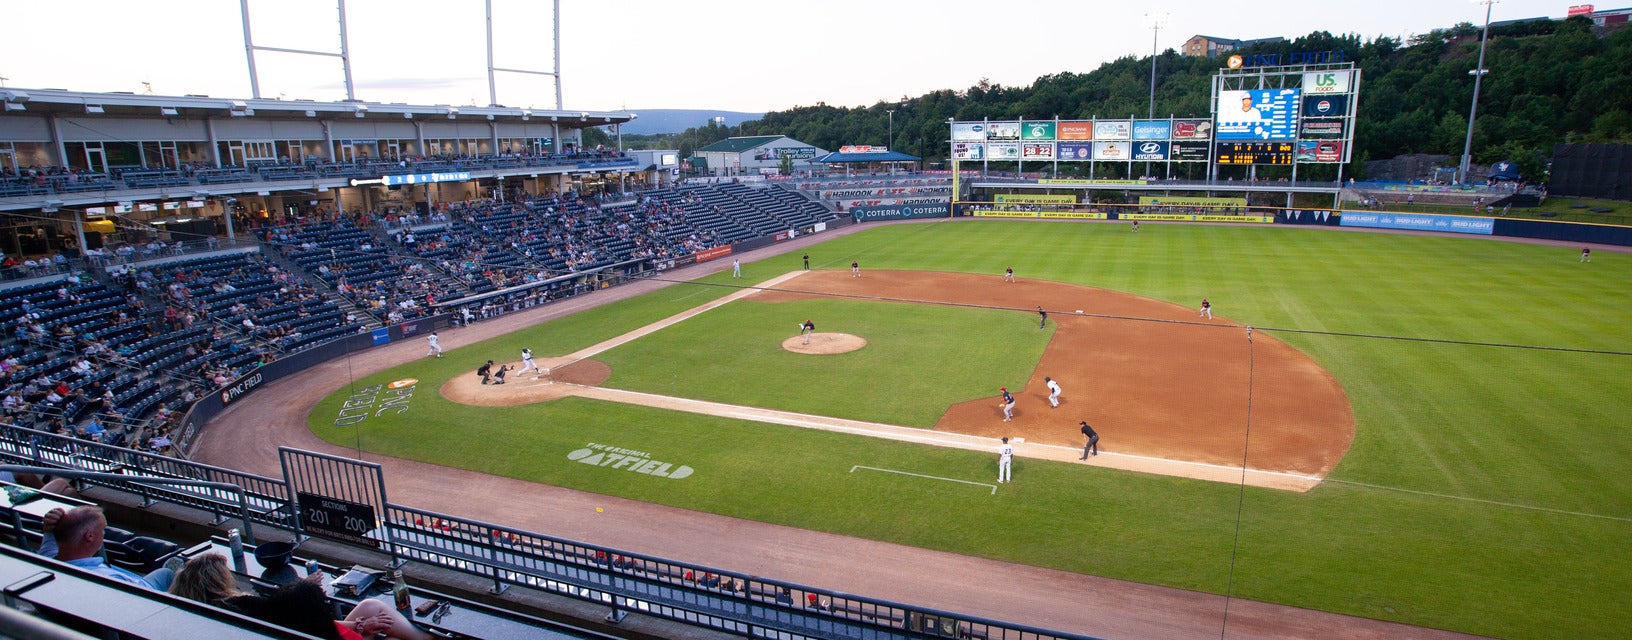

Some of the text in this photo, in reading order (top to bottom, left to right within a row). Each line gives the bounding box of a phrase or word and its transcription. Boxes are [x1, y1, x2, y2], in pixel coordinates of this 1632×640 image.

[1246, 50, 1345, 67] PNC FIELD
[1134, 126, 1167, 134] Geisinger
[229, 373, 262, 398] PNC FIELD
[334, 384, 382, 426] FIELD
[375, 386, 415, 417] PNC
[567, 448, 694, 479] OATFIELD
[604, 446, 651, 458] ORIGINAL
[322, 500, 347, 512] SECTIONS
[309, 508, 366, 532] 201 200
